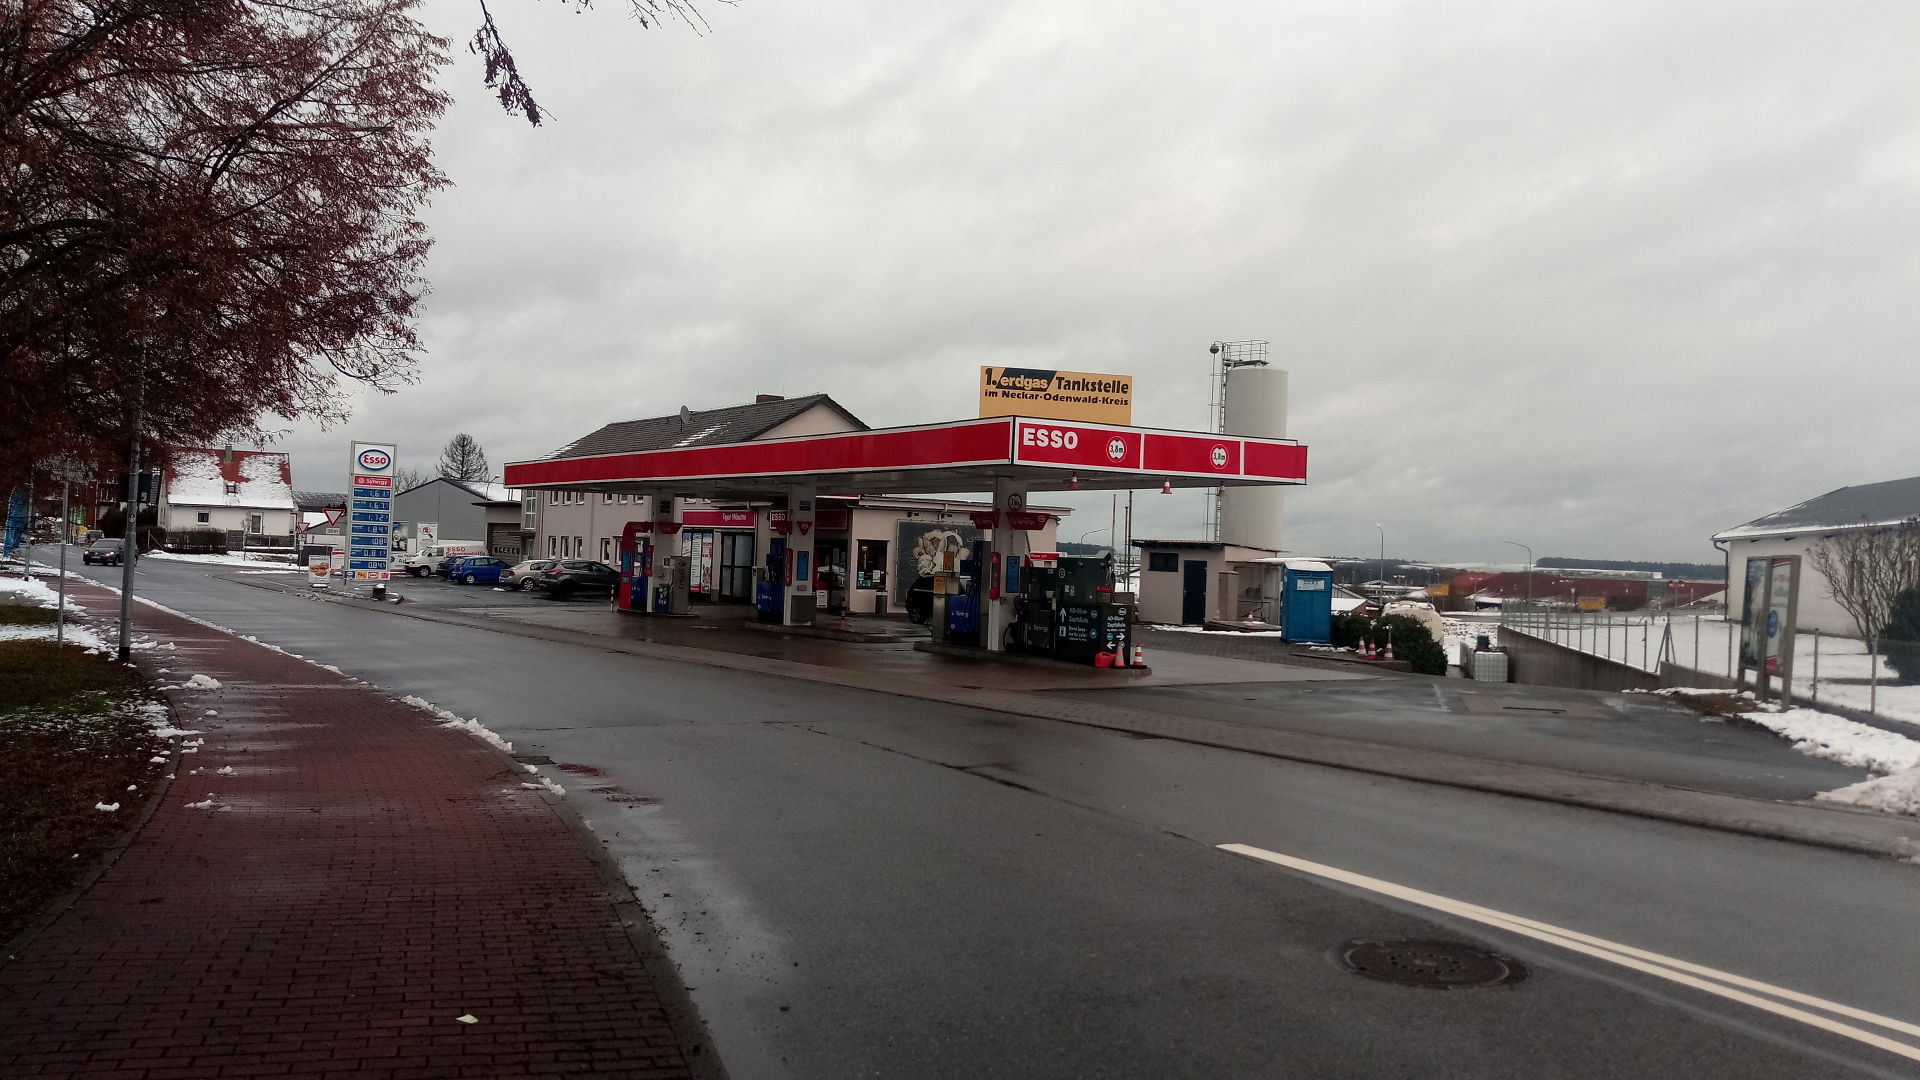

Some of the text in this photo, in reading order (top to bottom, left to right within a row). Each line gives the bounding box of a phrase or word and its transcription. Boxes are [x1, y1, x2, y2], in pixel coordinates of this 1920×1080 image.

[985, 367, 1129, 394] 1. erdgas Tankstelle
[984, 389, 998, 398] im
[1023, 427, 1078, 449] ESSO
[363, 454, 387, 464] Esso
[366, 478, 388, 486] Synergy
